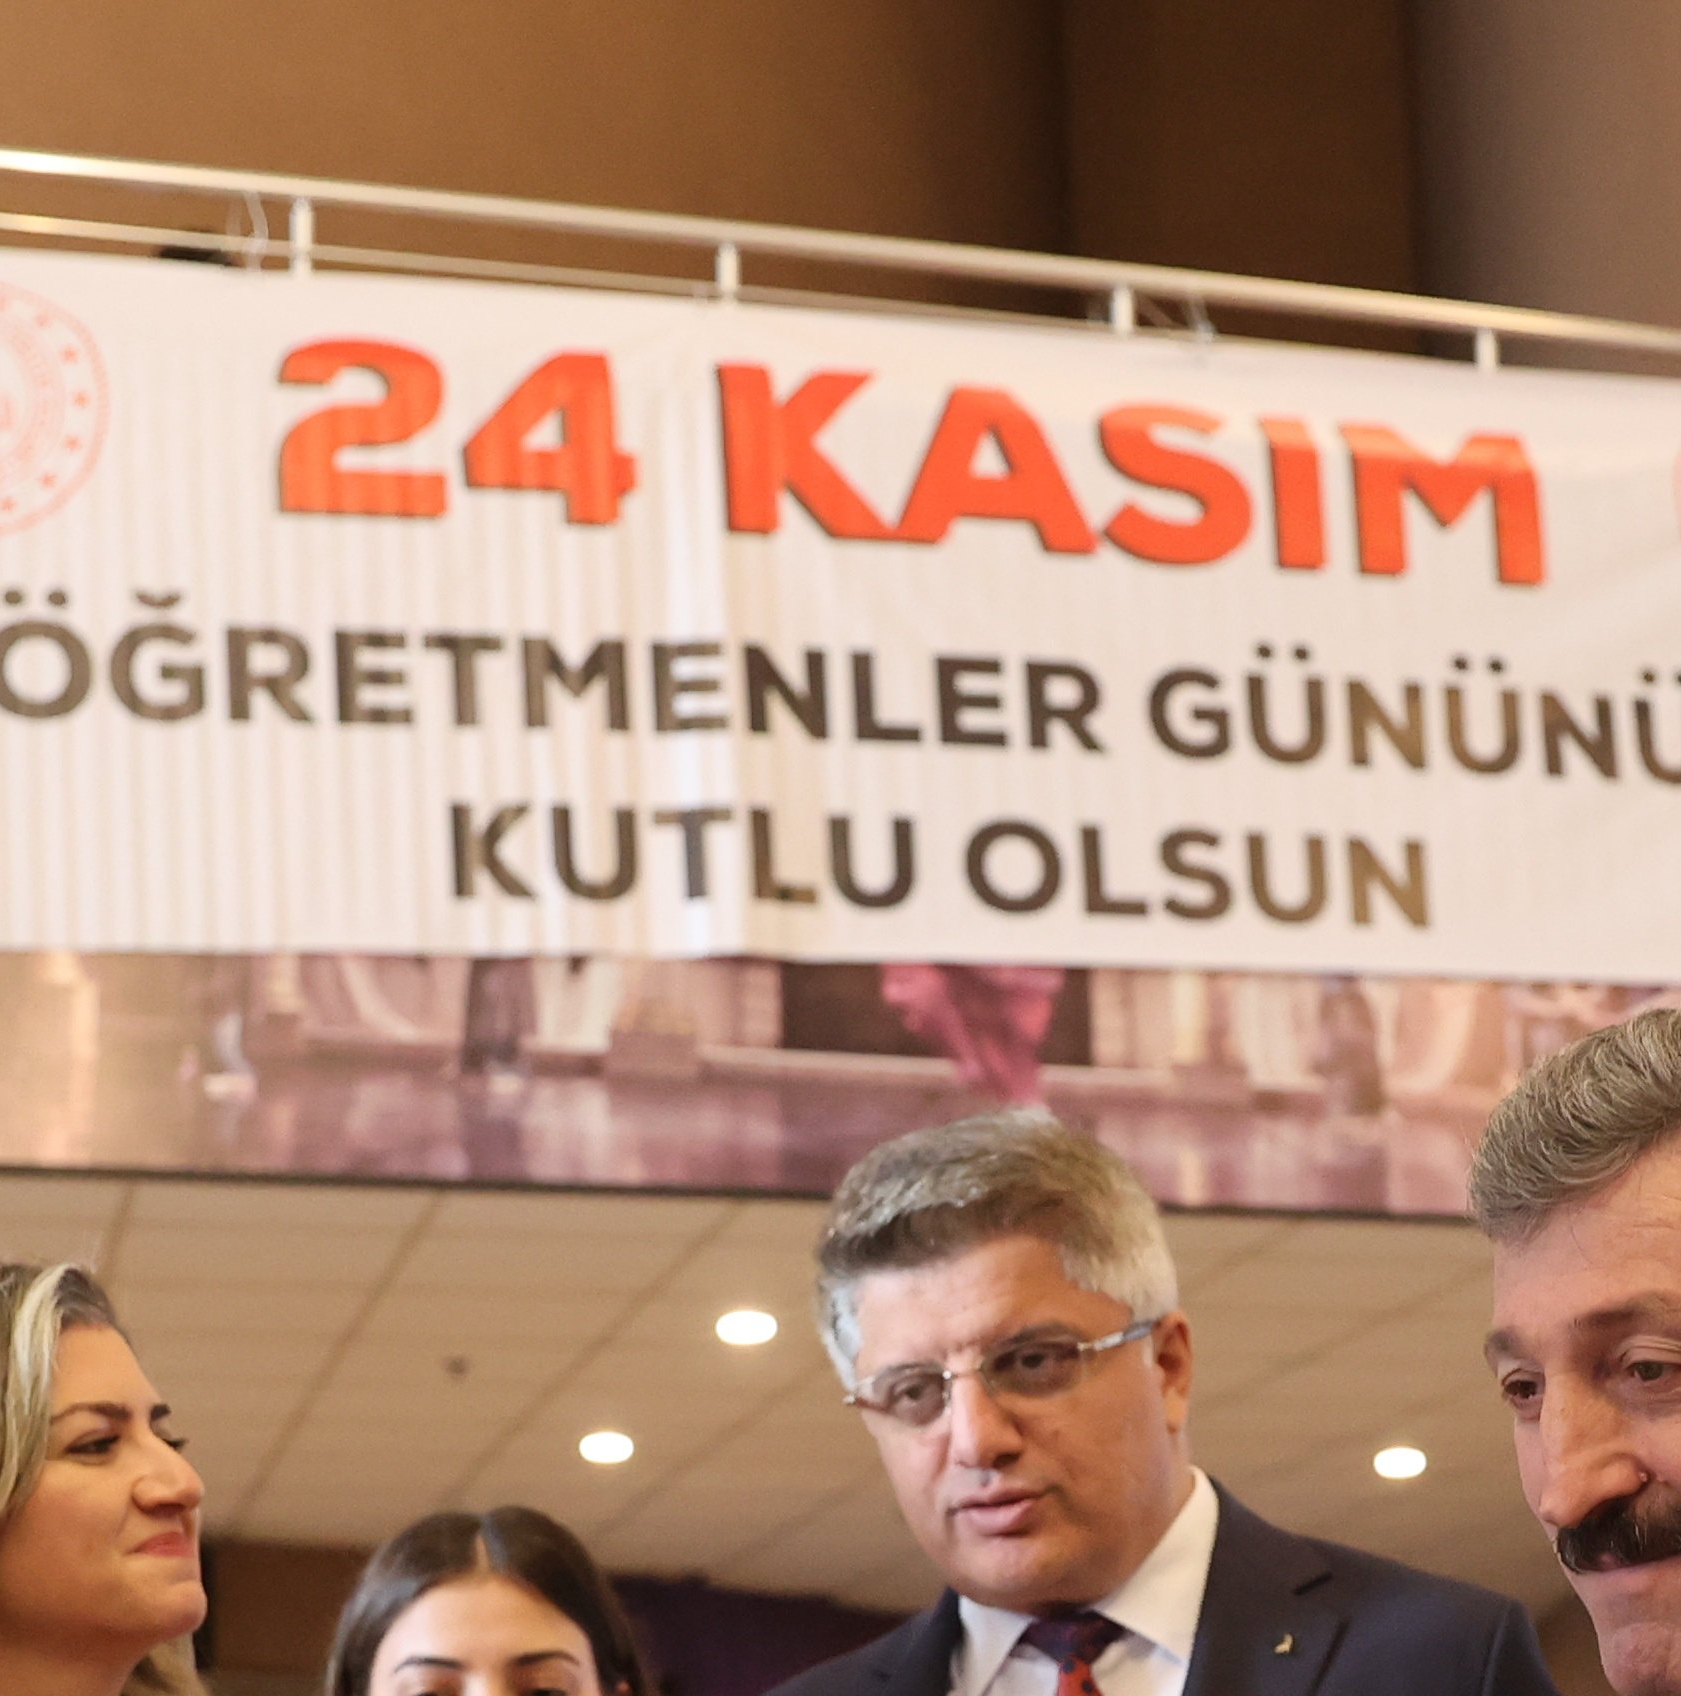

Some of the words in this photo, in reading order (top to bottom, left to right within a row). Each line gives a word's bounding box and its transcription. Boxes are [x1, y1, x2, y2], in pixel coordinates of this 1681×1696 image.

[276, 337, 640, 529] 24
[715, 362, 1548, 588] KASIM
[450, 802, 917, 910] KUTLU
[963, 820, 1435, 930] OLSUN
